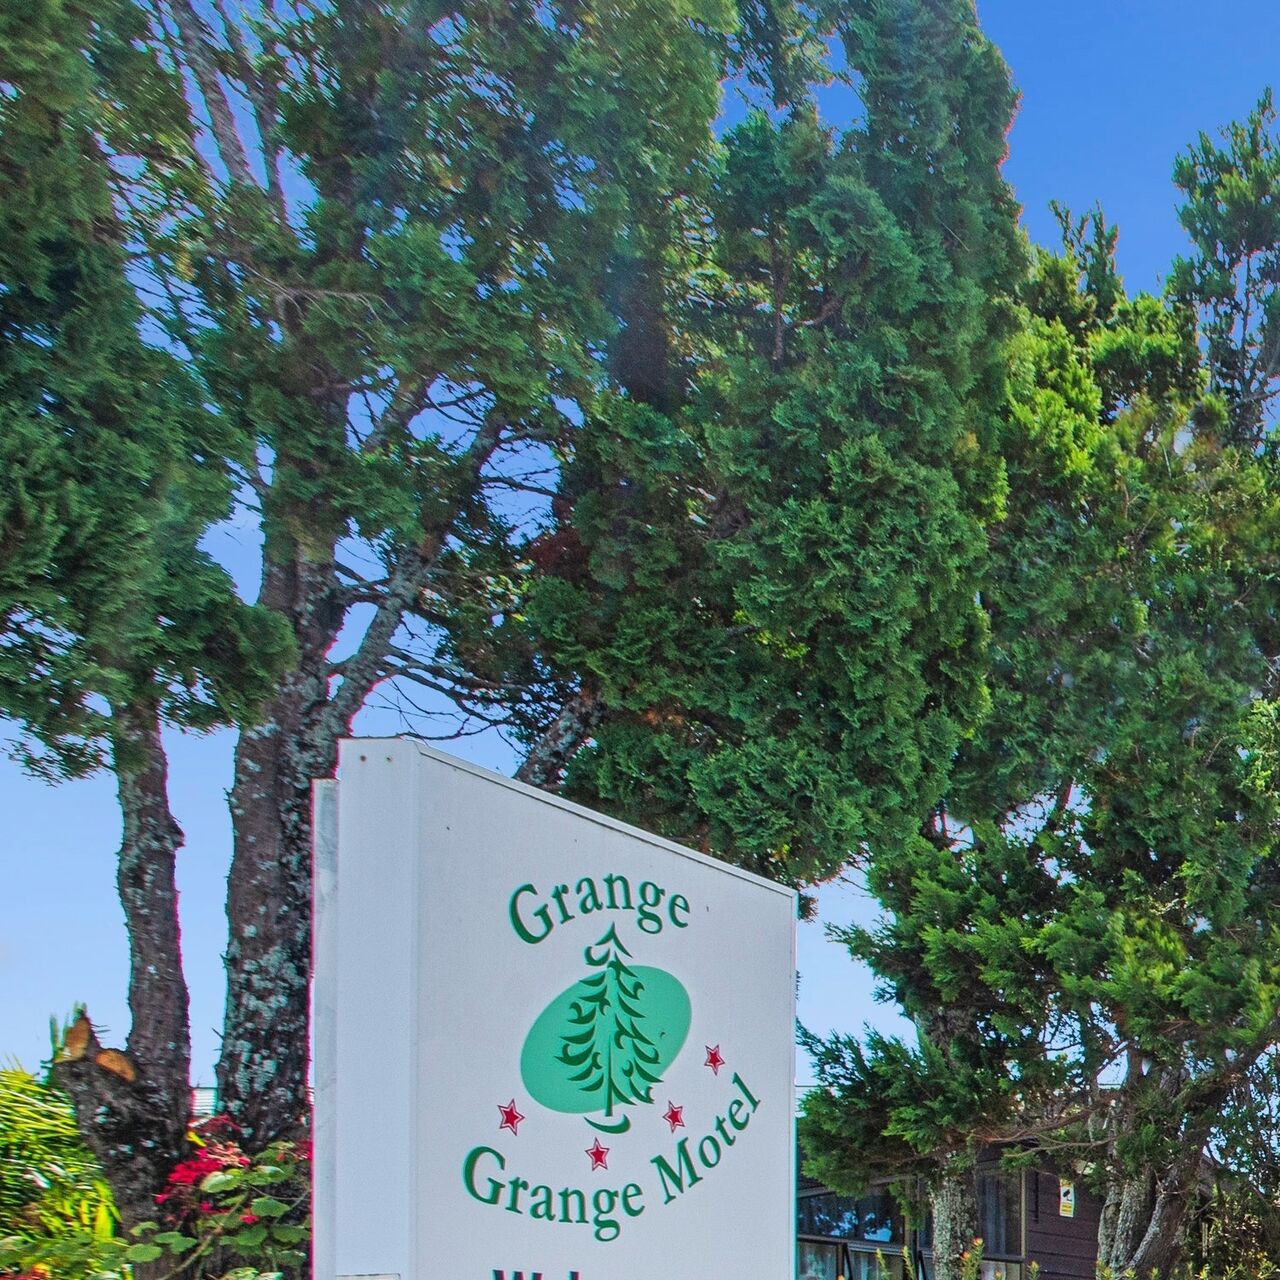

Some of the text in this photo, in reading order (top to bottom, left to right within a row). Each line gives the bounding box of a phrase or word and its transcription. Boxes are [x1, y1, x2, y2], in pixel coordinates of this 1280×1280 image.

[509, 873, 690, 944] Grange
[463, 1071, 761, 1242] Grange Motel
